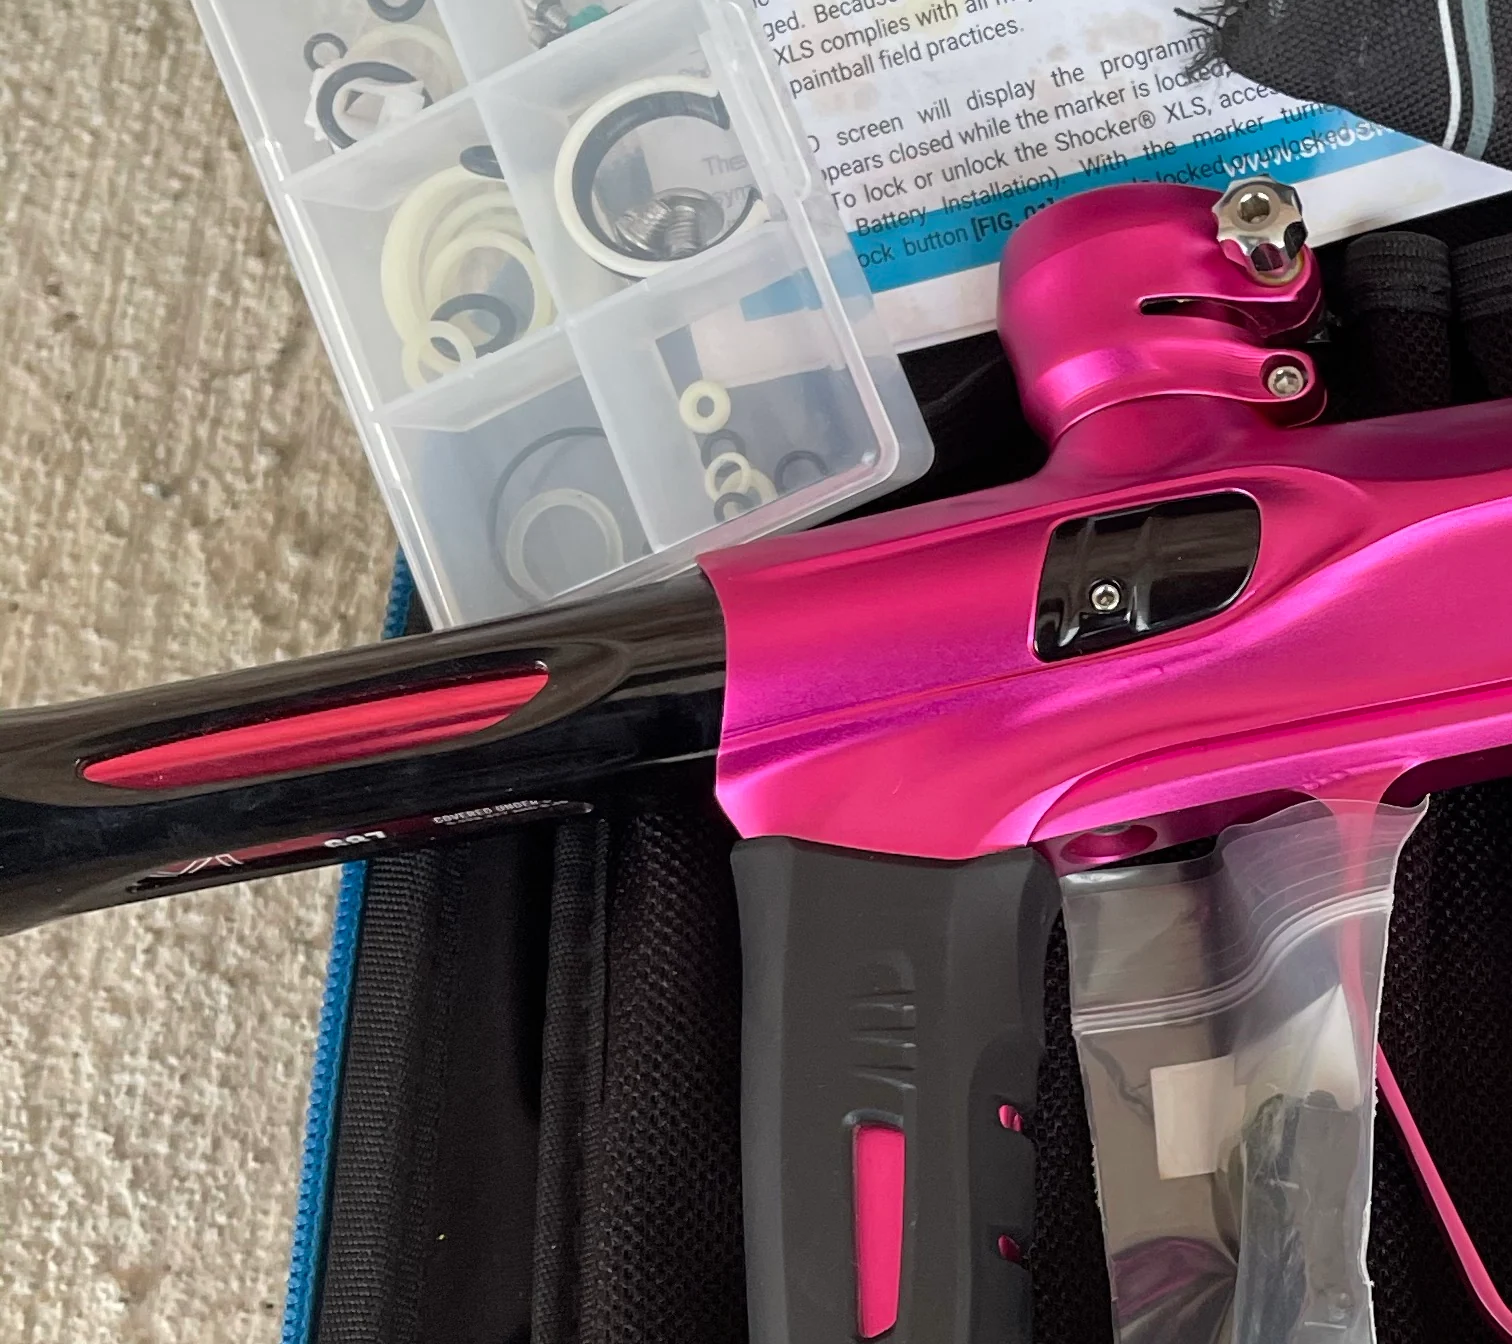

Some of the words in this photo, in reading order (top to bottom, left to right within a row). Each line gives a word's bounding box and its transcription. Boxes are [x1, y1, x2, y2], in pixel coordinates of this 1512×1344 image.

[773, 40, 814, 66] XLS
[821, 17, 910, 53] complies
[915, 0, 958, 26] with
[790, 54, 875, 99] paintball
[879, 41, 922, 69] field
[926, 20, 1024, 62] practices.
[821, 155, 883, 185] pears
[889, 130, 954, 164] closed
[958, 117, 1011, 144] while
[1015, 109, 1049, 130] the
[1054, 88, 1125, 120] marker
[1131, 81, 1150, 99] is
[837, 117, 904, 145] screen
[917, 98, 951, 123] will
[967, 80, 1035, 110] display
[1051, 67, 1084, 87] the
[831, 192, 856, 210] To
[863, 176, 907, 203] lock
[914, 172, 933, 190] or
[942, 151, 1009, 183] unlock
[1014, 142, 1048, 162] the
[1055, 110, 1156, 151] Shocker®
[1163, 97, 1212, 124] XLS,
[856, 206, 926, 237] Battery
[1079, 150, 1128, 177] With
[1143, 141, 1177, 161] the
[1193, 115, 1264, 148] marker
[904, 227, 969, 256] button
